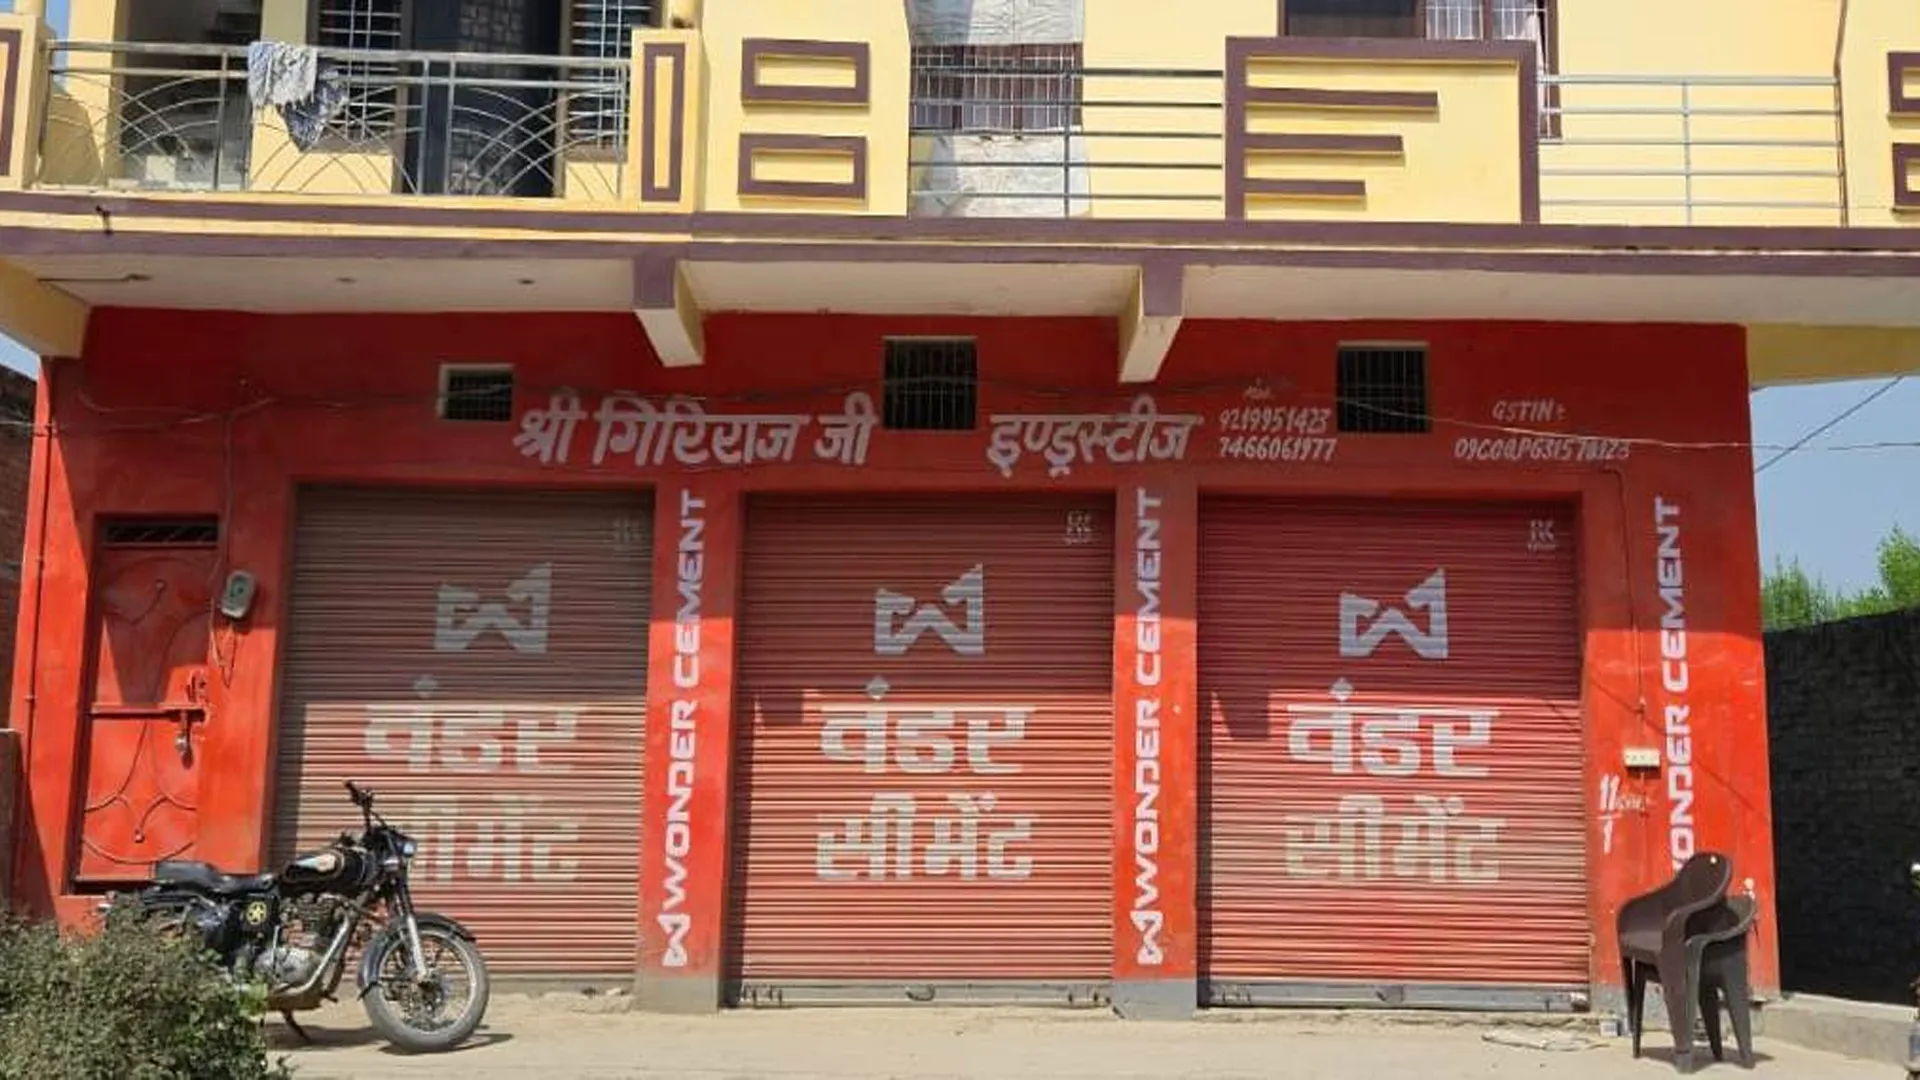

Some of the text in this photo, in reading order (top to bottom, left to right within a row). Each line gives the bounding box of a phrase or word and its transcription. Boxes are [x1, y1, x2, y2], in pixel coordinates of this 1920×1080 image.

[514, 387, 587, 465] श्री
[594, 391, 810, 466] गिरिराज
[815, 392, 879, 465] जी
[1220, 435, 1337, 461] 7466061977
[1655, 497, 1689, 694] CEMENT
[364, 675, 588, 774] वंडर
[661, 489, 707, 911] WONDER CEMENT
[820, 675, 1038, 774] वंडर
[1131, 488, 1162, 908] WONDER CEMENT
[1286, 677, 1501, 777] वंडर
[815, 791, 1041, 882] सीमेंट
[1284, 794, 1507, 885] सीमेंट
